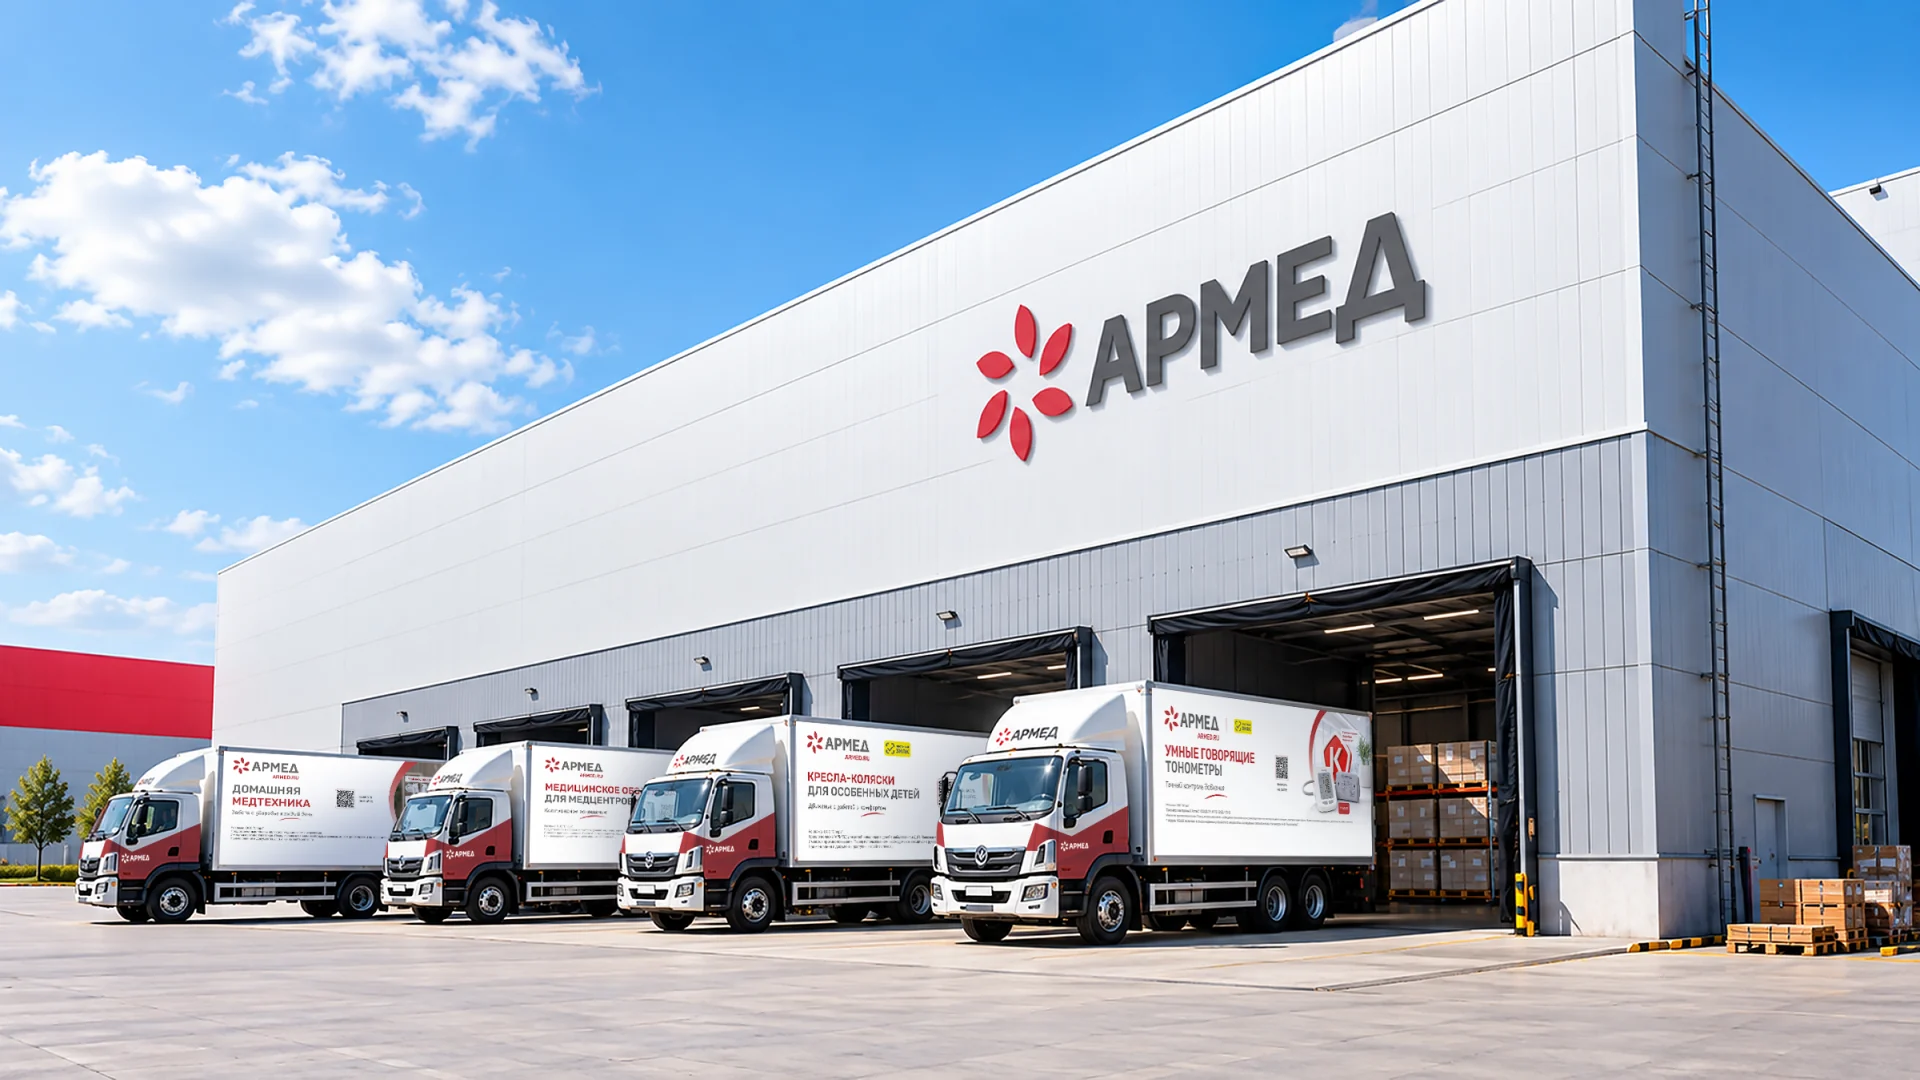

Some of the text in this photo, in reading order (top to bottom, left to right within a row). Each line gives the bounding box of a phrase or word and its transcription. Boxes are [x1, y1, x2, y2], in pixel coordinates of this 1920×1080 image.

[1085, 211, 1426, 407] АРМЕД
[1180, 712, 1220, 731] АРМЕД
[1010, 726, 1059, 742] АРМЕД
[825, 737, 870, 752] АРМЕД
[1165, 744, 1256, 765] УМНЫЕ ГОВОРЯЩИЕ
[251, 761, 299, 773] АРМЕД
[561, 760, 604, 773] АРМЕД
[1164, 760, 1223, 777] ТОНОМЕТРЫ
[807, 771, 896, 786] КРЕСЛА-КОЛЯСКИ
[232, 784, 301, 796] ДОМАШНЯЯ
[545, 783, 621, 795] МЕДИЦИНСКОЕ
[807, 785, 920, 800] ДЛЯ ОСОБЕННЫХ ДЕТЕЙ
[232, 796, 311, 808] МЕДТЕХНИКА
[544, 794, 567, 804] ДЛЯ
[130, 854, 150, 862] АРМЕД
